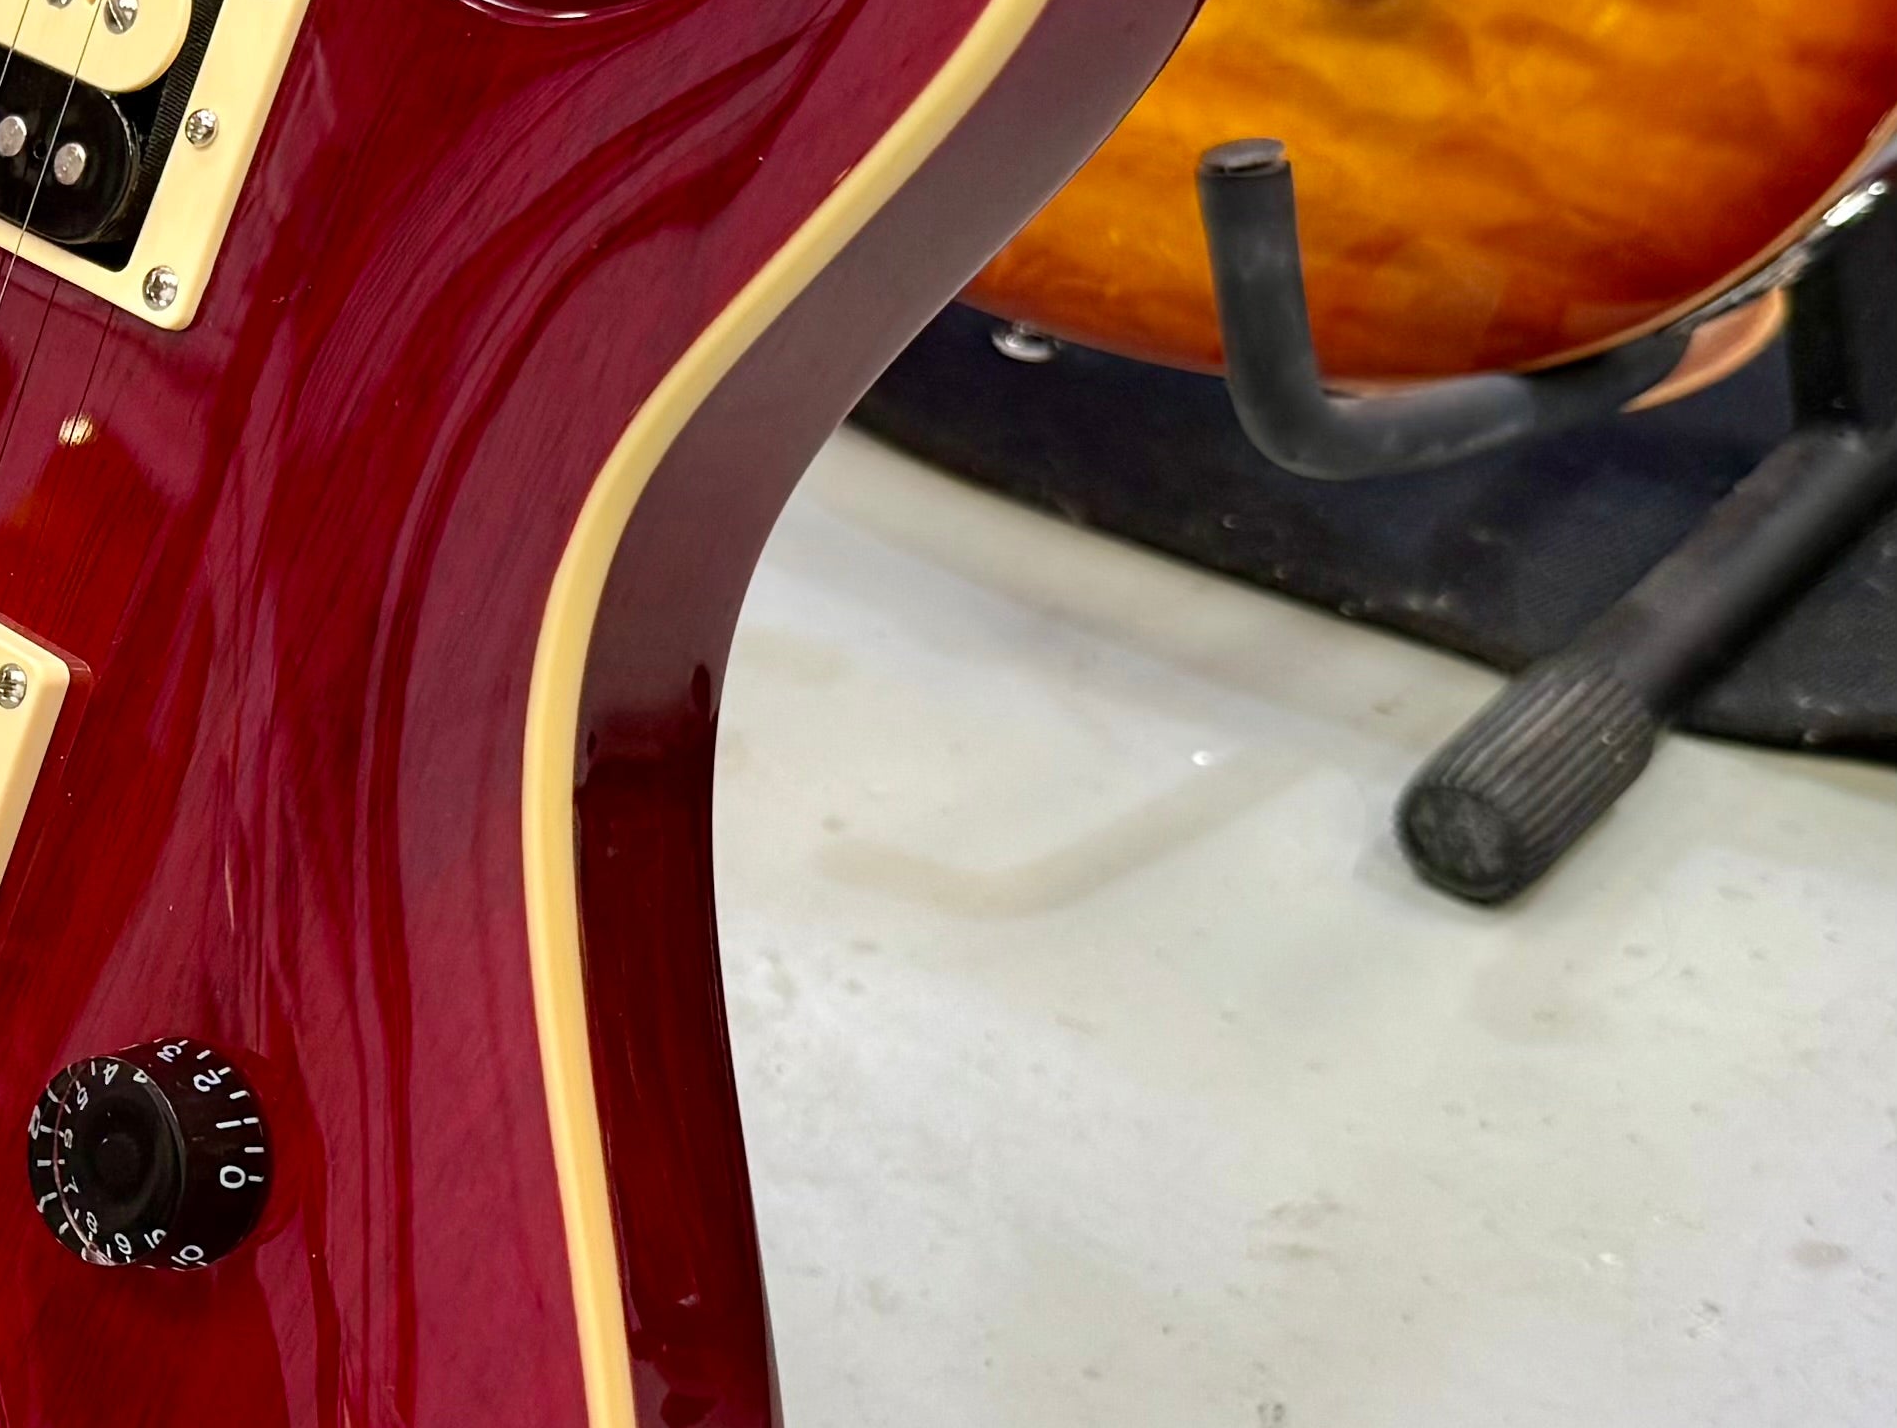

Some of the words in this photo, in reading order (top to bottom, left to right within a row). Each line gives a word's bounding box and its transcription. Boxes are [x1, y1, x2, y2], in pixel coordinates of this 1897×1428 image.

[157, 1044, 183, 1063] 3
[103, 1063, 120, 1085] 4
[193, 1068, 222, 1092] 2
[219, 1165, 247, 1189] 0
[86, 1211, 98, 1234] 8
[170, 1244, 205, 1266] 10
